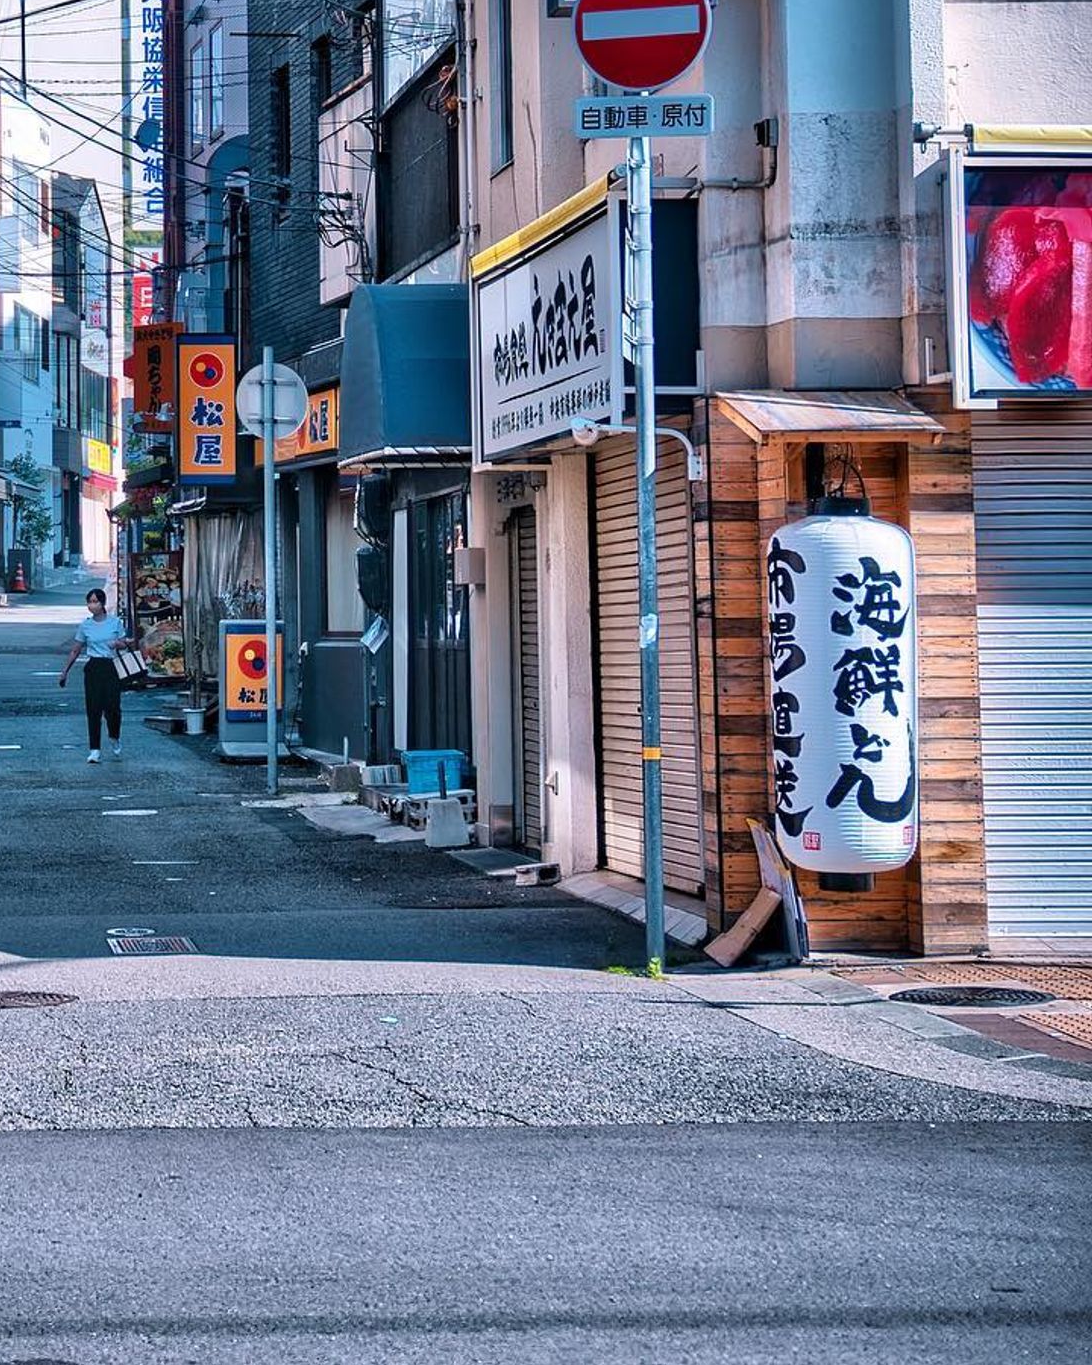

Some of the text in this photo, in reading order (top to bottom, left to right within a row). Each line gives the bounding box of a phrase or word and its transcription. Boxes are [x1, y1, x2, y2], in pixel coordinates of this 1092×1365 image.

[581, 103, 707, 131] 自動車・原付
[190, 396, 224, 466] 松屋
[826, 556, 916, 824] 海鮮どん
